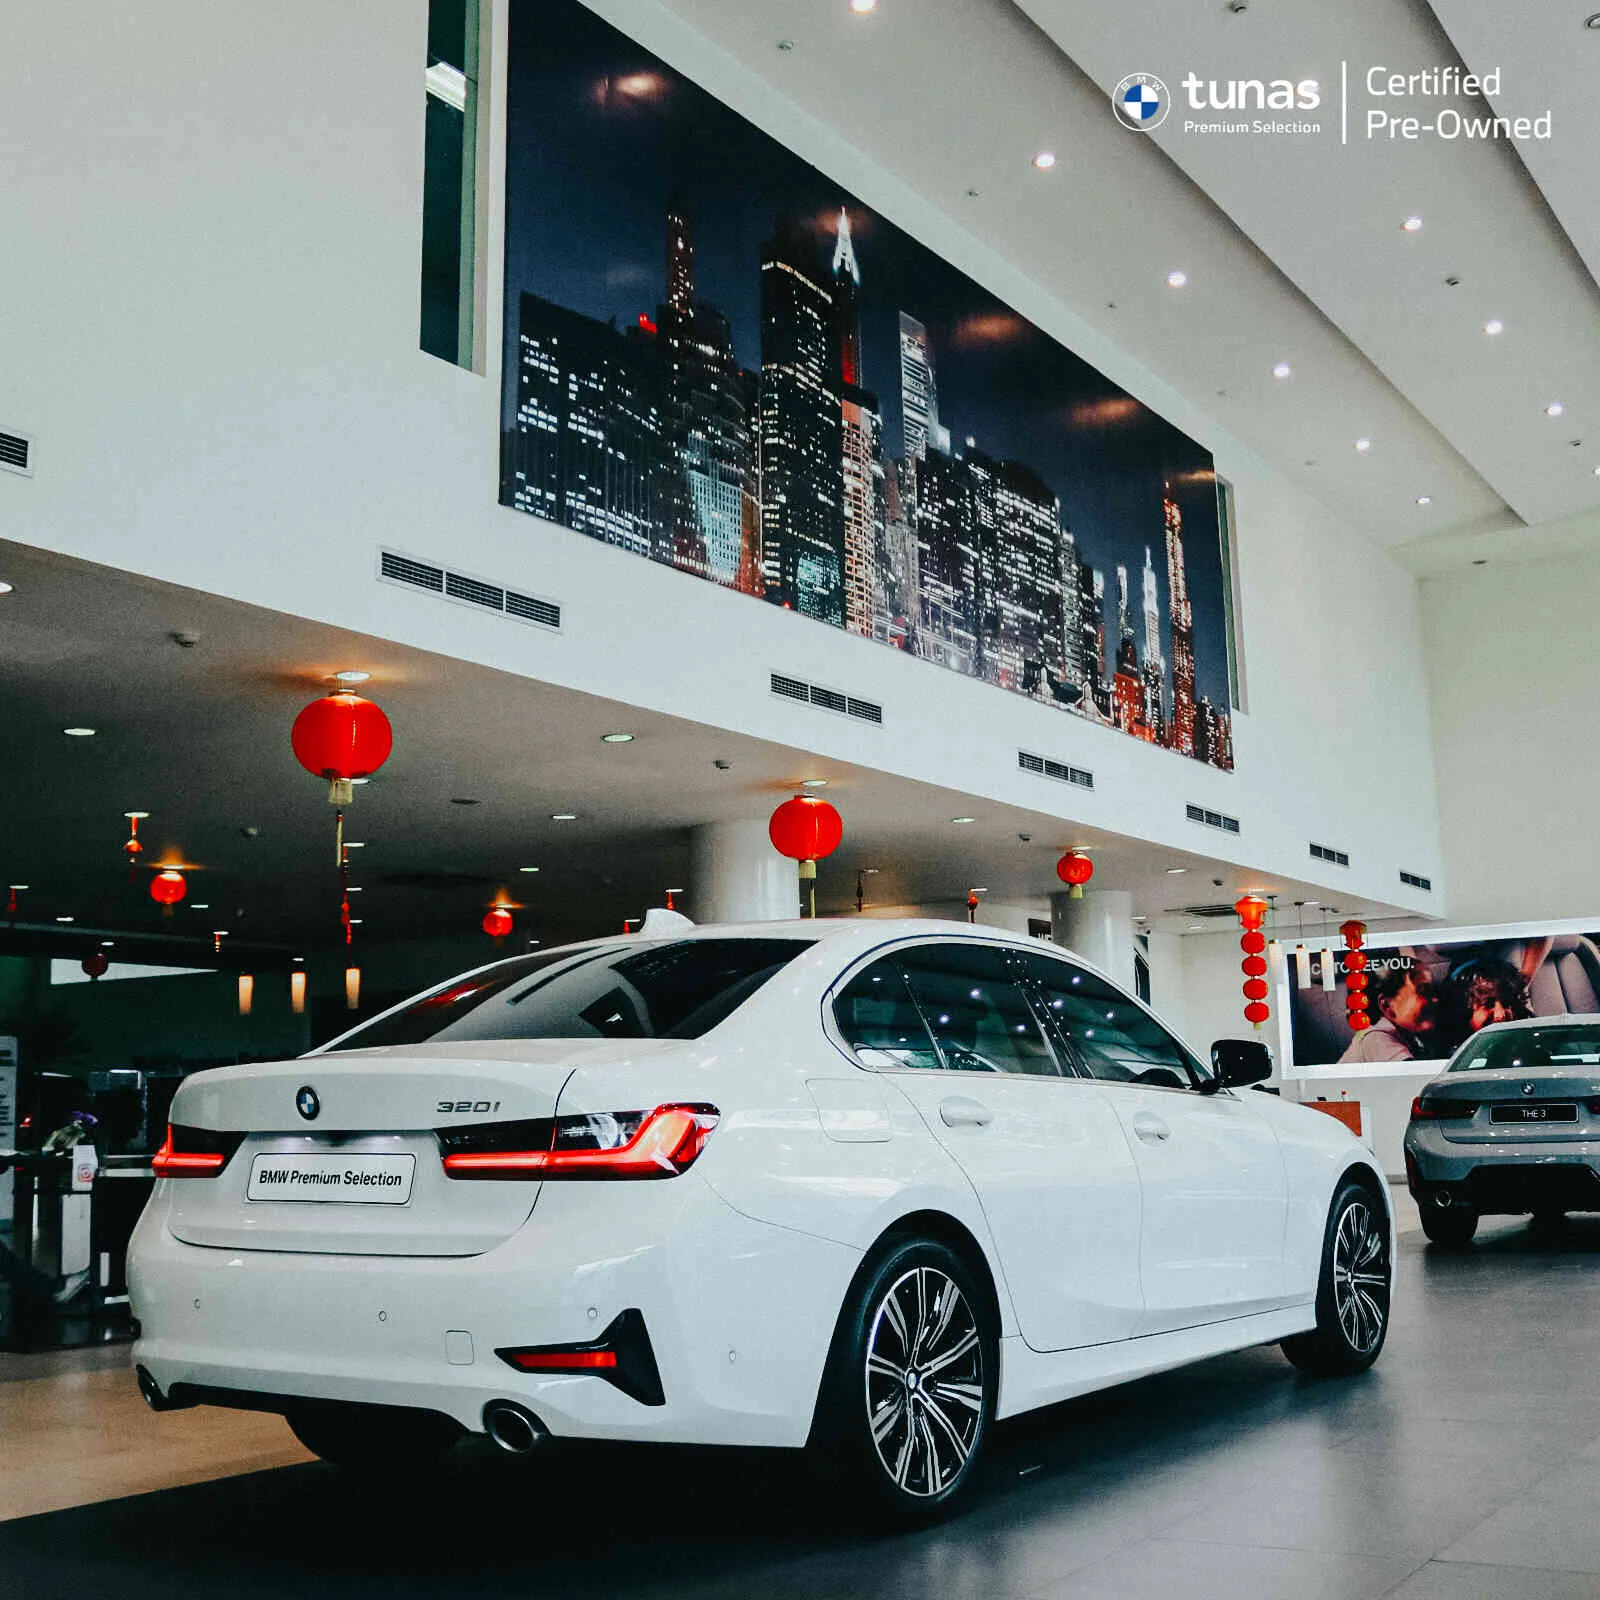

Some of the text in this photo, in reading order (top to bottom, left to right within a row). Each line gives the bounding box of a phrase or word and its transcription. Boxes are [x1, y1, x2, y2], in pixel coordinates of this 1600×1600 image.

[1381, 957, 1414, 970] YOU.
[436, 1101, 501, 1113] 320i
[1520, 1109, 1546, 1118] THE 3
[259, 1170, 402, 1186] BMW Premium Selection
